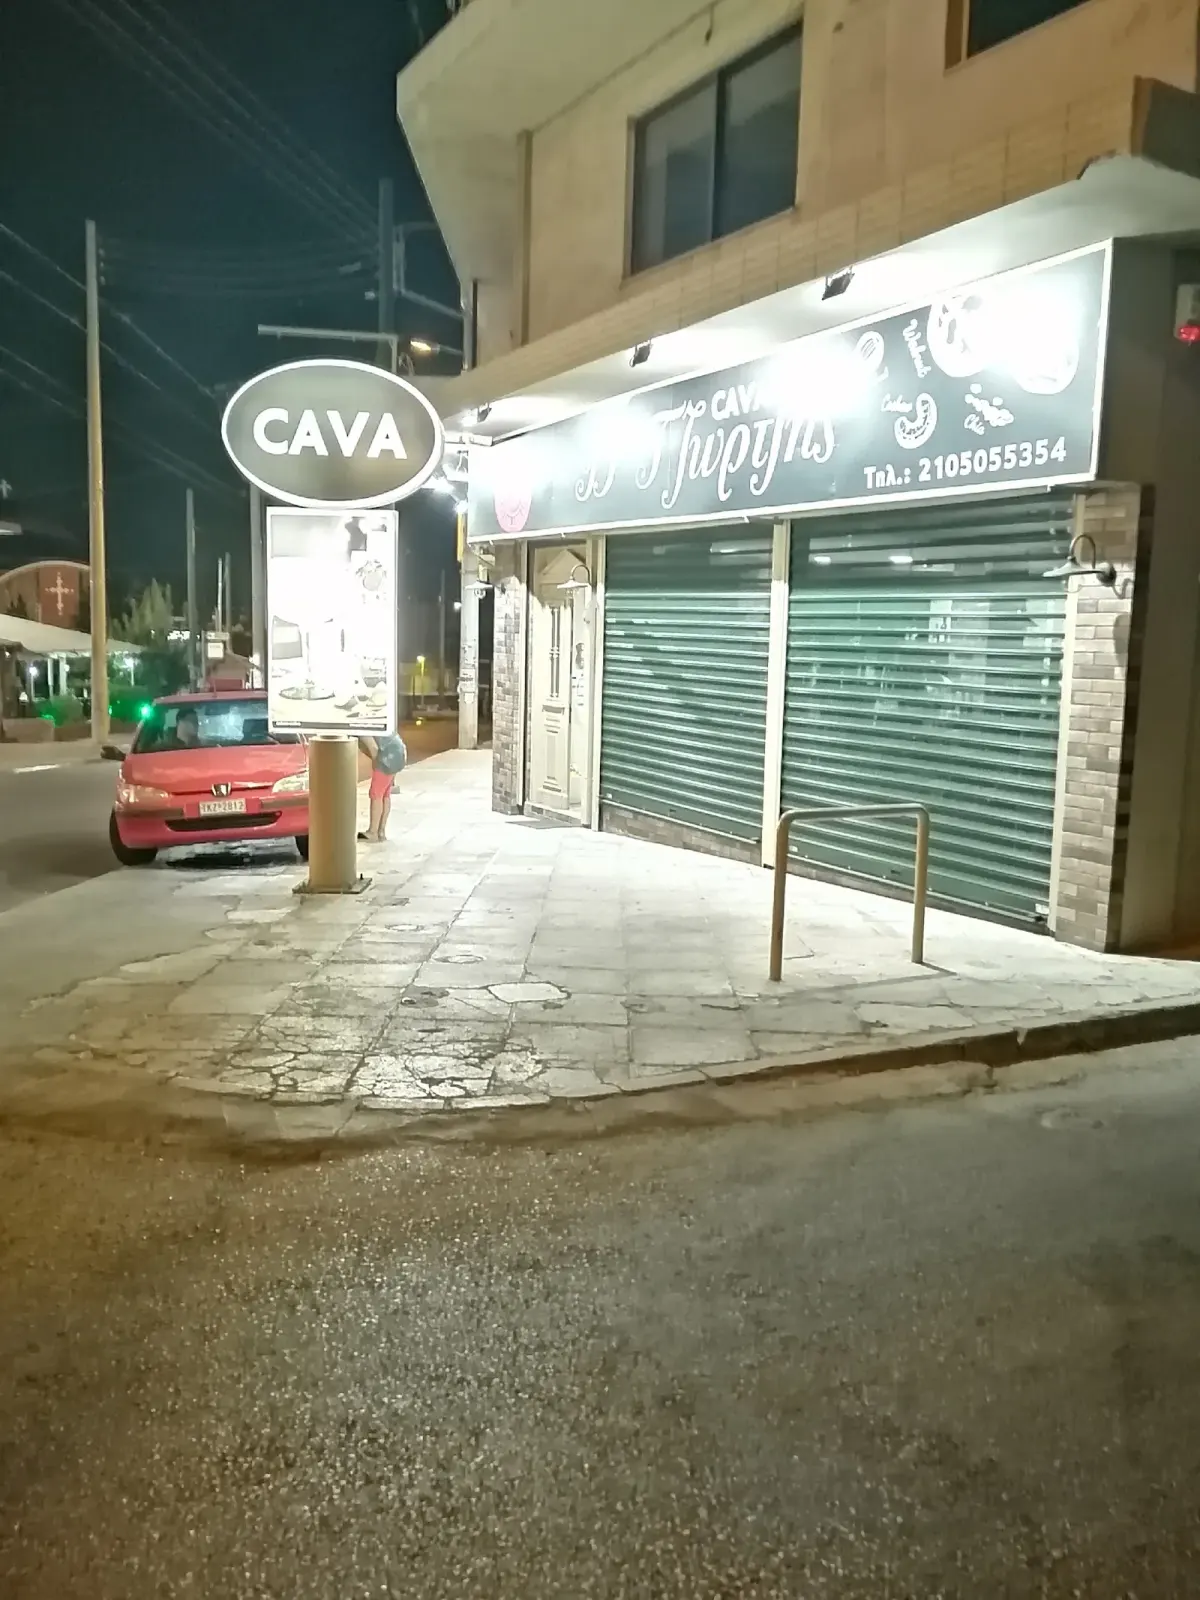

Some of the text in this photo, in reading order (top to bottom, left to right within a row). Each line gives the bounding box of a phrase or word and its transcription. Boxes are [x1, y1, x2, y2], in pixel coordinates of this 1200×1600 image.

[711, 379, 767, 421] CAV
[252, 407, 408, 460] CAVA
[918, 436, 1067, 482] 2105055354
